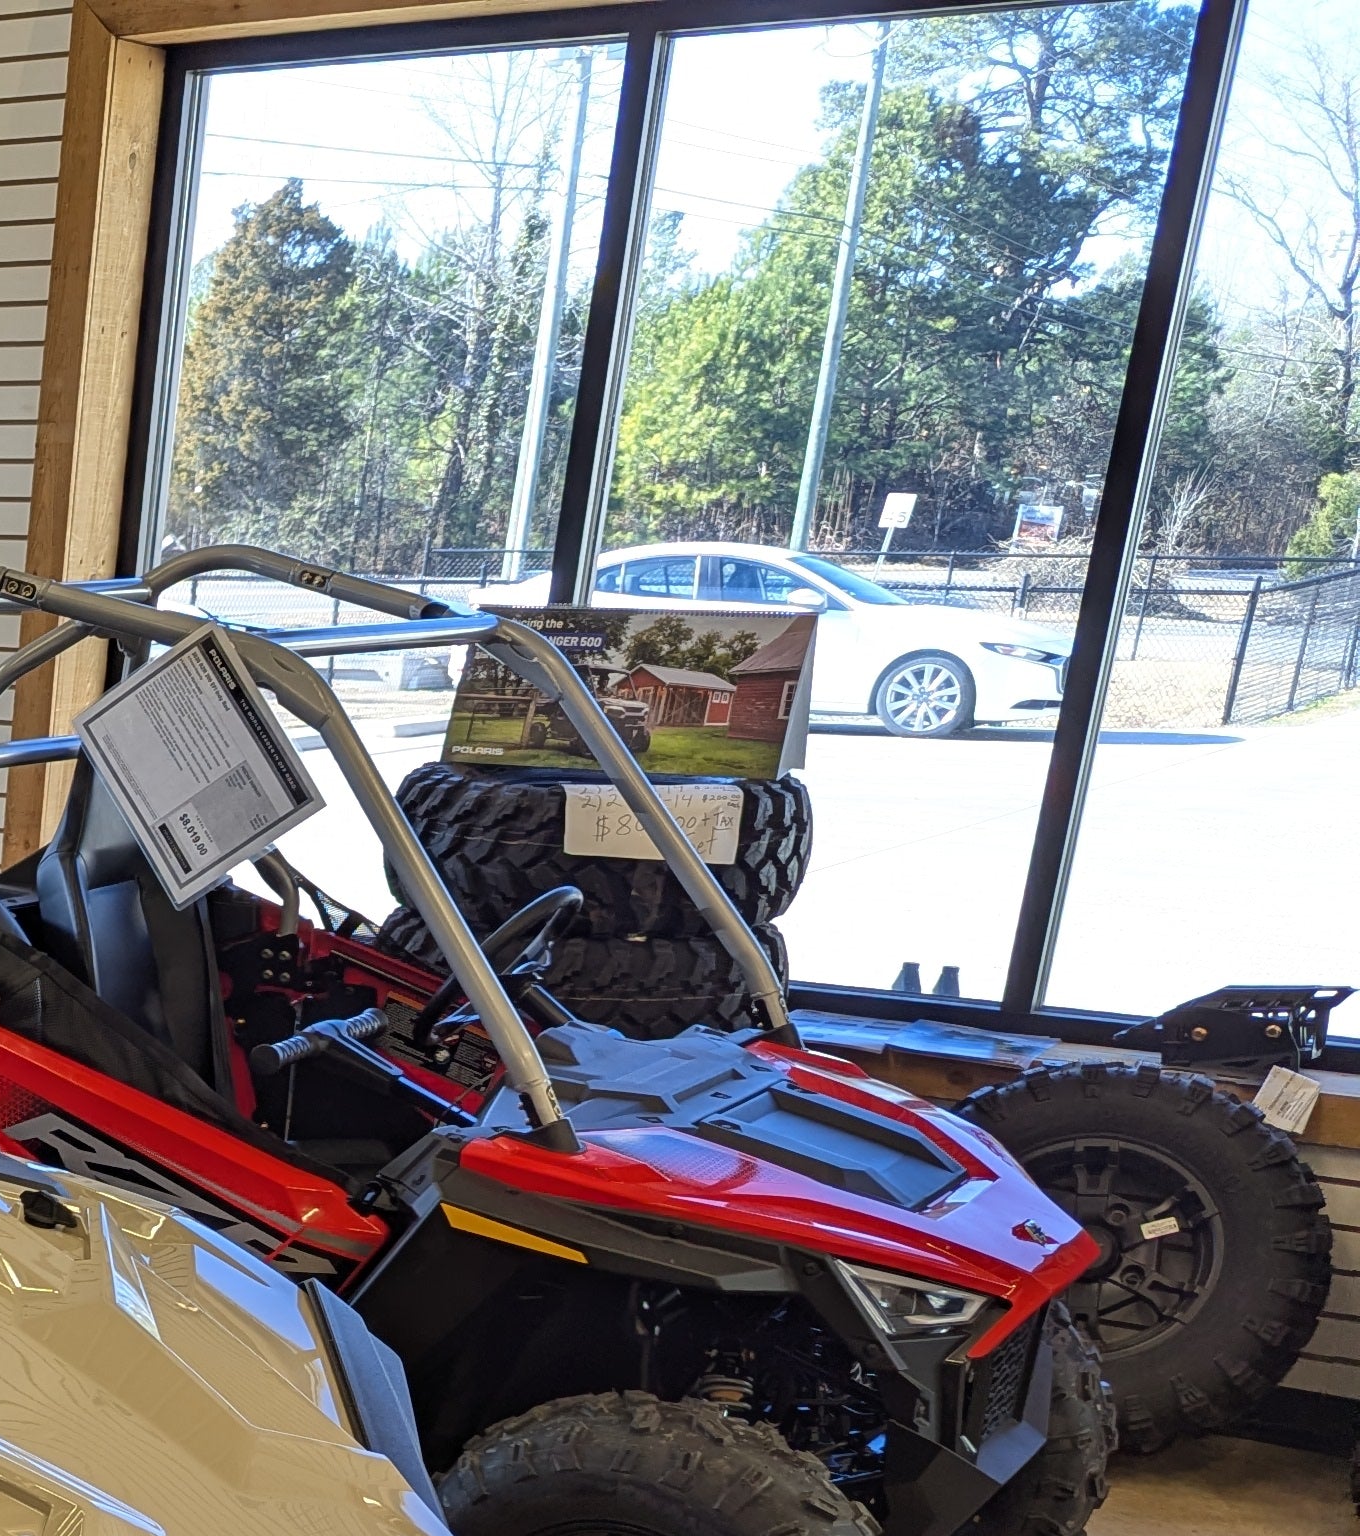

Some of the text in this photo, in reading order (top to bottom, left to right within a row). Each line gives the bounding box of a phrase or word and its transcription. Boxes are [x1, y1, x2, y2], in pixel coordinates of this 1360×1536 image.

[545, 618, 564, 629] the
[544, 635, 602, 648] NGER 500
[207, 647, 237, 690] POLARIS
[451, 745, 504, 756] POLARIS
[176, 812, 208, 856] $8,019.00
[4, 1112, 337, 1275] RZR
